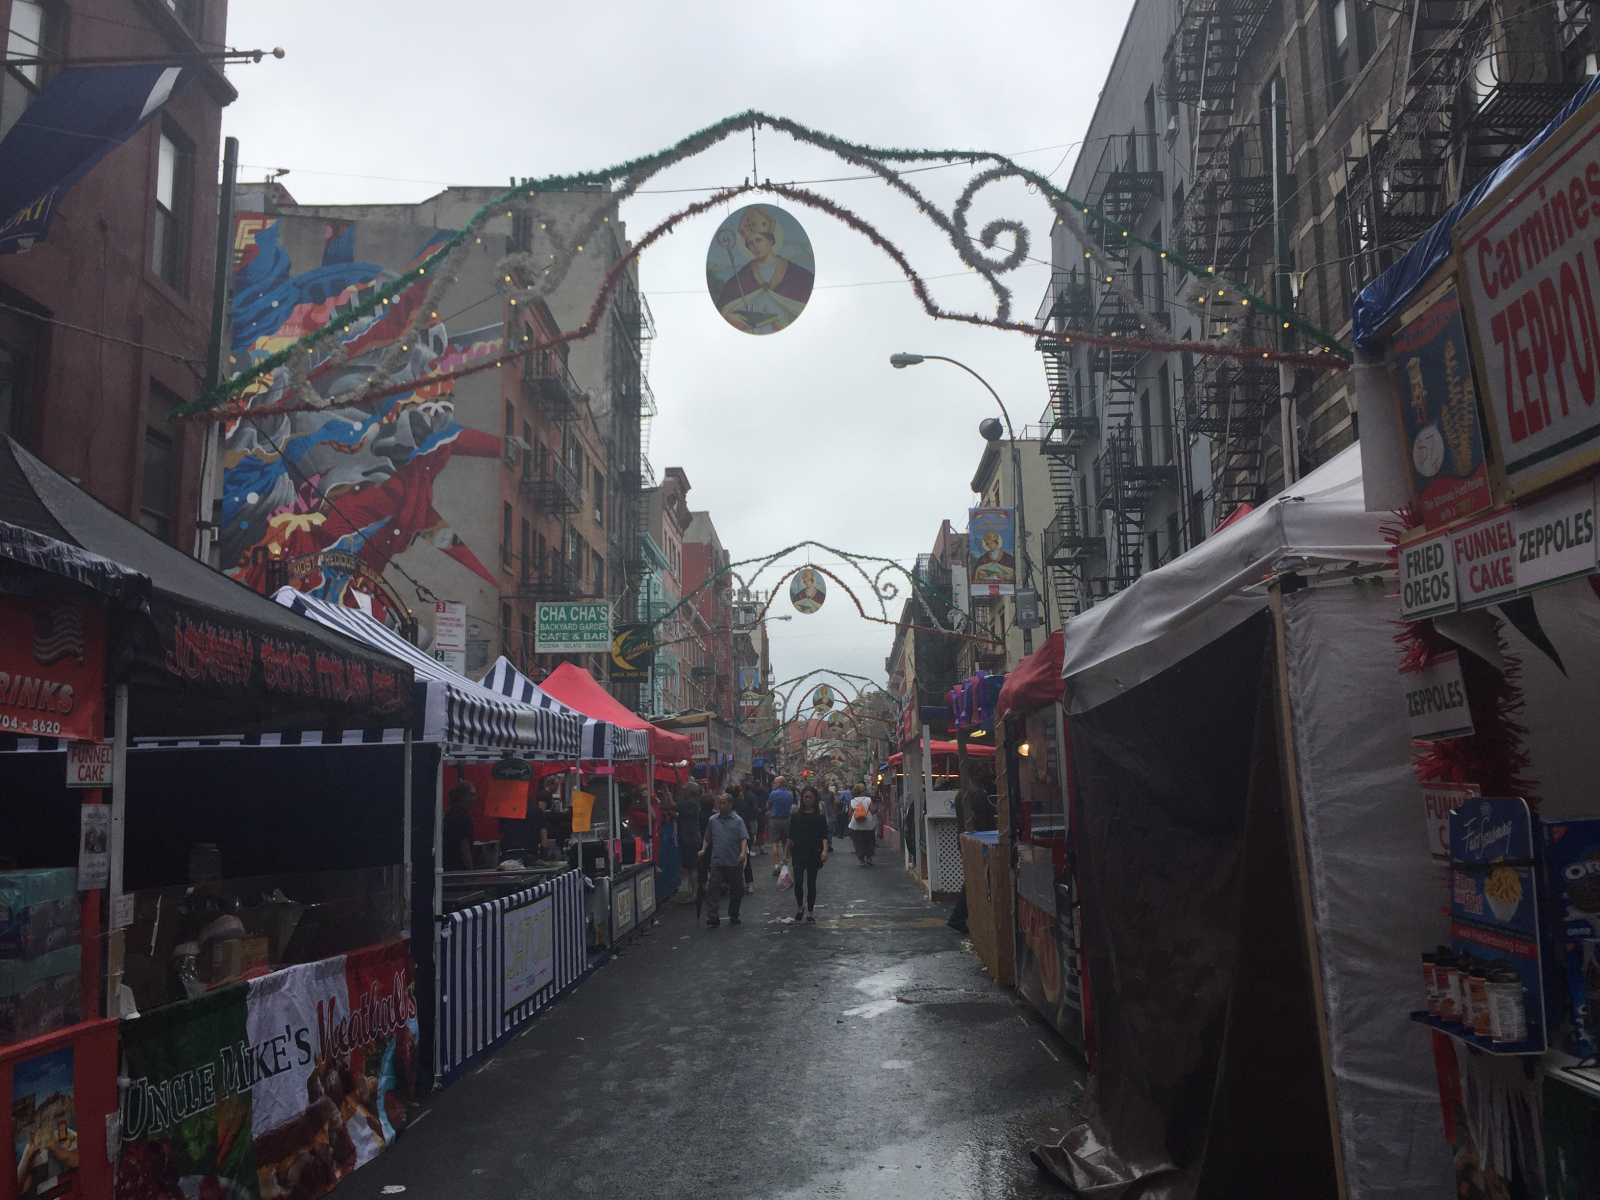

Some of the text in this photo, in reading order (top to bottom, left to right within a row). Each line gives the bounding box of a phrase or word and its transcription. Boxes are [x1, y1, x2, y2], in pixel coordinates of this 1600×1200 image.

[1454, 520, 1517, 565] FUNNEL
[1518, 508, 1594, 564] ZEPPOLES
[293, 557, 316, 577] MOST
[320, 554, 356, 568] PRECIOUS
[1406, 542, 1445, 579] FRIED
[1469, 557, 1514, 594] CAKE
[1403, 571, 1451, 609] OREOS
[437, 602, 444, 612] 3
[540, 605, 608, 621] CHA CHA'S
[539, 632, 607, 641] CAFE & BAR
[540, 622, 608, 631] BACKYARD GARDEN
[436, 651, 443, 661] 2
[1405, 680, 1464, 717] ZEPPOLES
[32, 718, 60, 734] 8620
[71, 746, 111, 764] FUNNEL
[77, 764, 105, 782] CAKE
[121, 967, 418, 1142] UNCLE MIKE'S Meatballs
